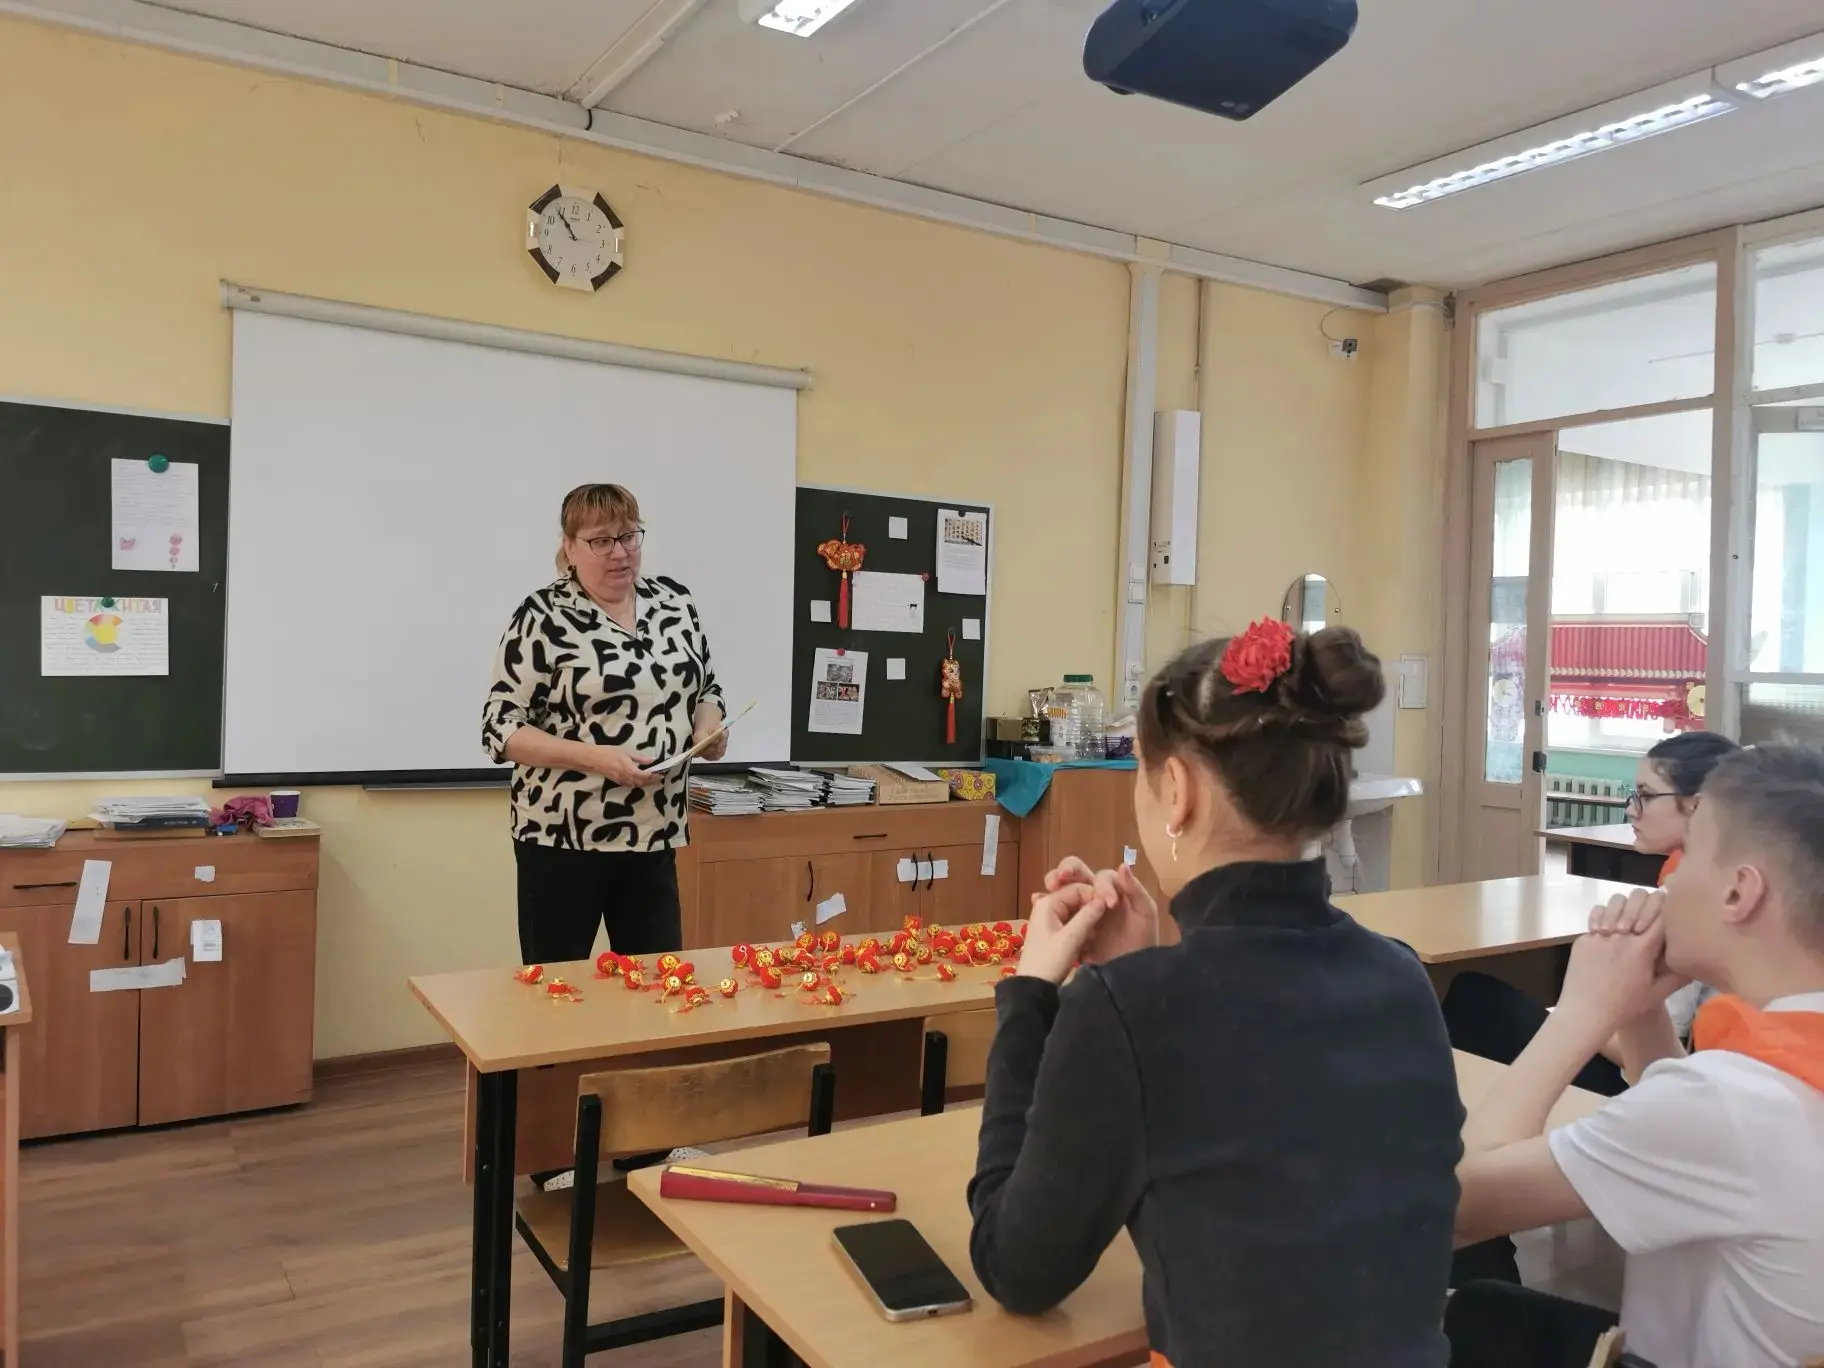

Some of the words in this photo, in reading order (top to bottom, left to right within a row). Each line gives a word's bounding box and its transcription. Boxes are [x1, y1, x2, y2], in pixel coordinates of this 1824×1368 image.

[572, 205, 580, 216] 12
[547, 215, 555, 225] 10
[586, 213, 591, 222] 1
[596, 225, 601, 234] 2
[600, 240, 605, 249] 3
[547, 245, 553, 254] 8
[557, 256, 563, 265] 7
[571, 263, 576, 276] 6
[586, 262, 591, 272] 5
[55, 598, 103, 614] ЦВЕТА
